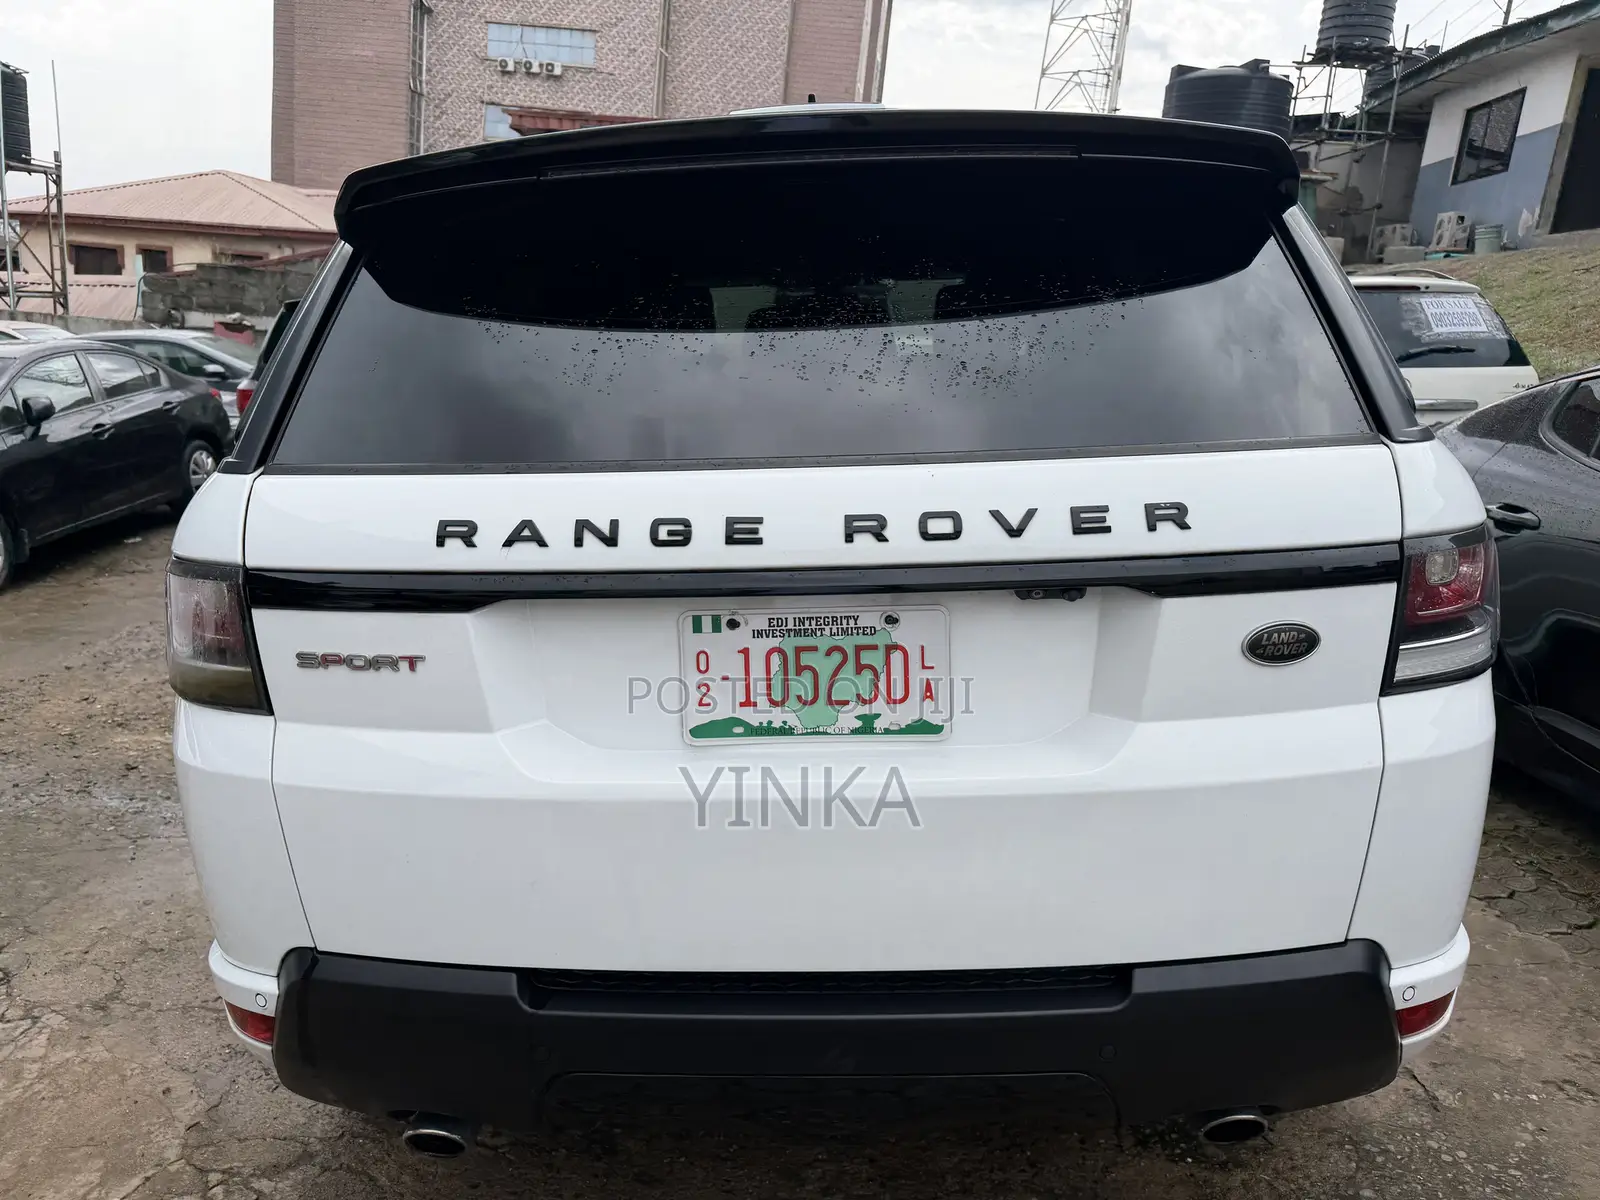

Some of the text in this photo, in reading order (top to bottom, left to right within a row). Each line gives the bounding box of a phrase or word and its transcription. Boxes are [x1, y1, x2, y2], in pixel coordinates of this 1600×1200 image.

[1424, 299, 1473, 310] FOR SALE
[436, 502, 1192, 548] RANGE ROVER
[767, 615, 860, 628] EDJ INTEGRITY
[752, 626, 877, 639] INVESTMENT LIMITED
[1261, 631, 1298, 645] LAND
[1264, 642, 1308, 656] ROVER
[295, 651, 427, 673] SPORT
[750, 728, 790, 736] FEDERAL
[847, 726, 884, 735] NIGERIA
